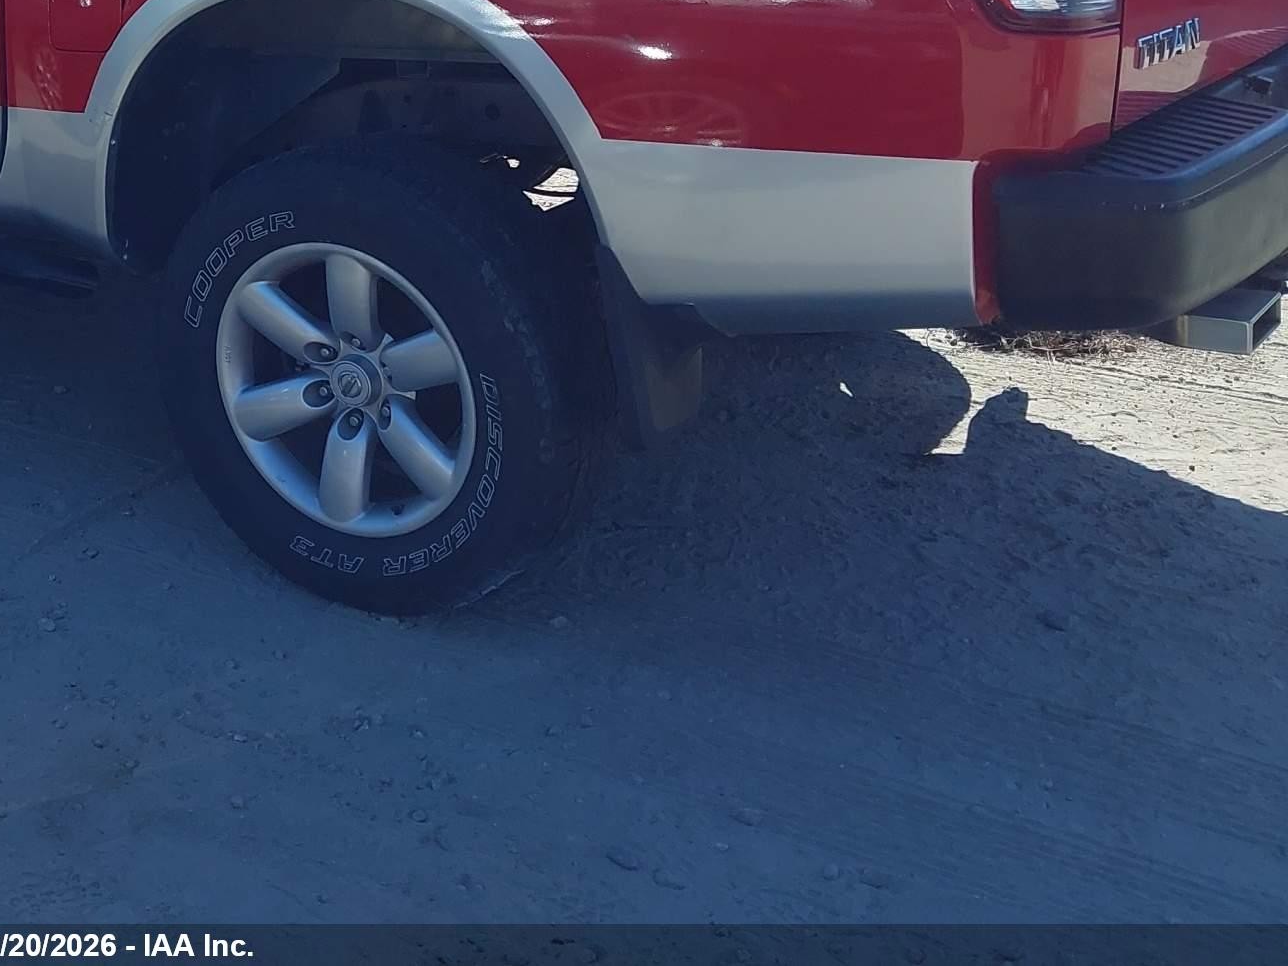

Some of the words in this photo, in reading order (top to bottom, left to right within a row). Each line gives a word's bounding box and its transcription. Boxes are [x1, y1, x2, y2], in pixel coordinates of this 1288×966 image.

[1136, 17, 1202, 70] TITAN
[183, 210, 296, 329] COOPER
[382, 373, 504, 577] DISCOVERER
[289, 535, 365, 575] AT3
